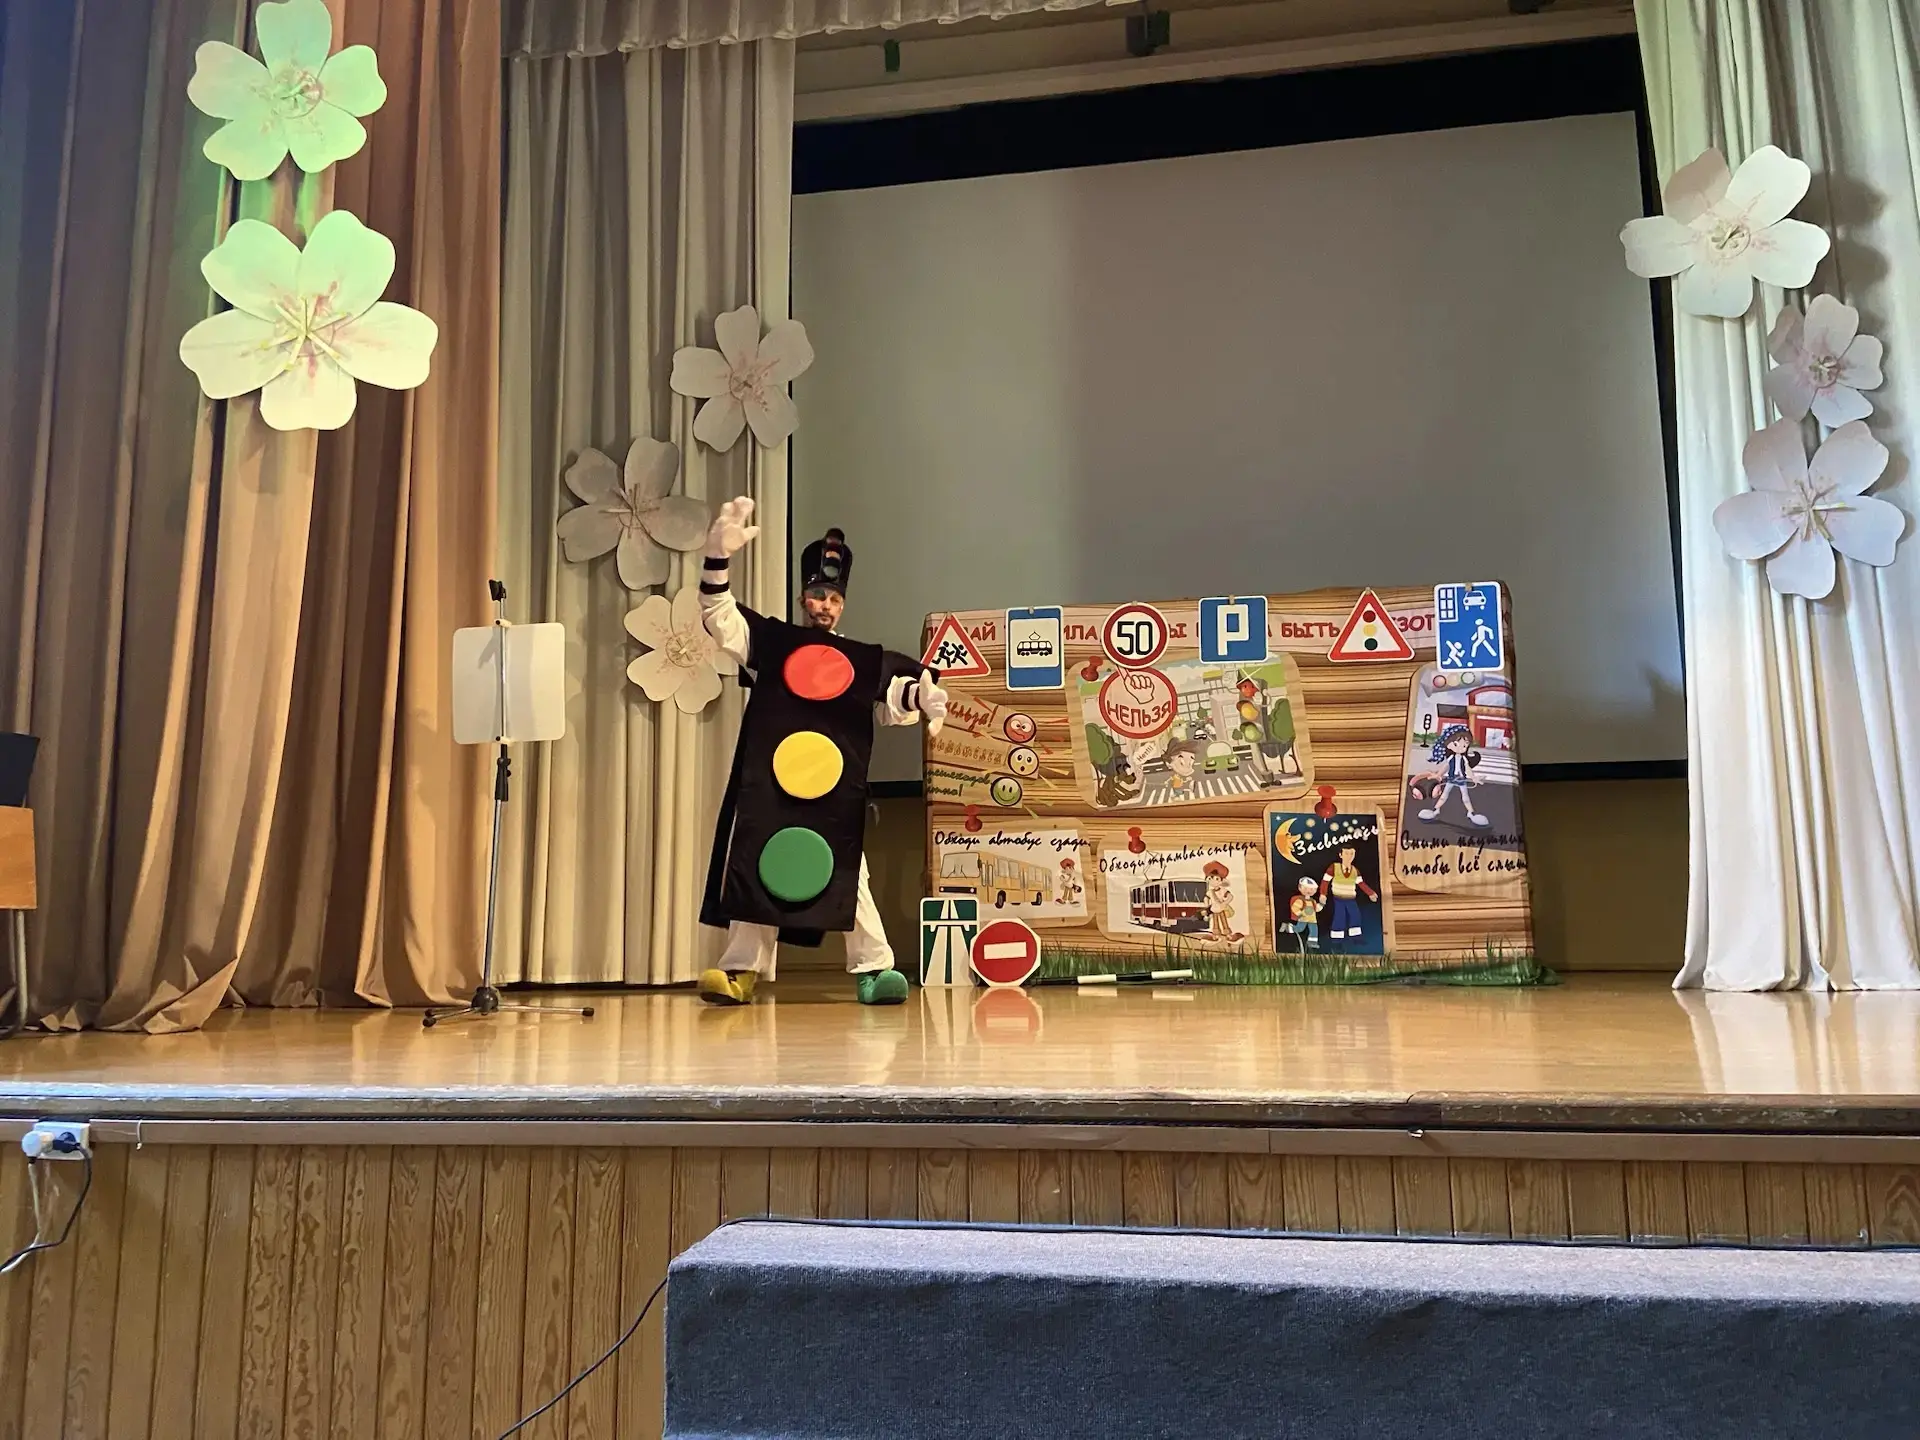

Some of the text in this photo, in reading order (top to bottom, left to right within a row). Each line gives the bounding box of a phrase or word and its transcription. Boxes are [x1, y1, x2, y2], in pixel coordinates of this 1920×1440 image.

[1116, 621, 1154, 656] 50
[1216, 604, 1250, 656] P
[1281, 621, 1341, 639] БЫТЬ
[1106, 700, 1171, 728] НЕЛЬЗЯ
[935, 831, 980, 850] Обходи
[988, 831, 1042, 851] автобус
[1099, 856, 1145, 875] Обходи
[1458, 851, 1480, 874] всё
